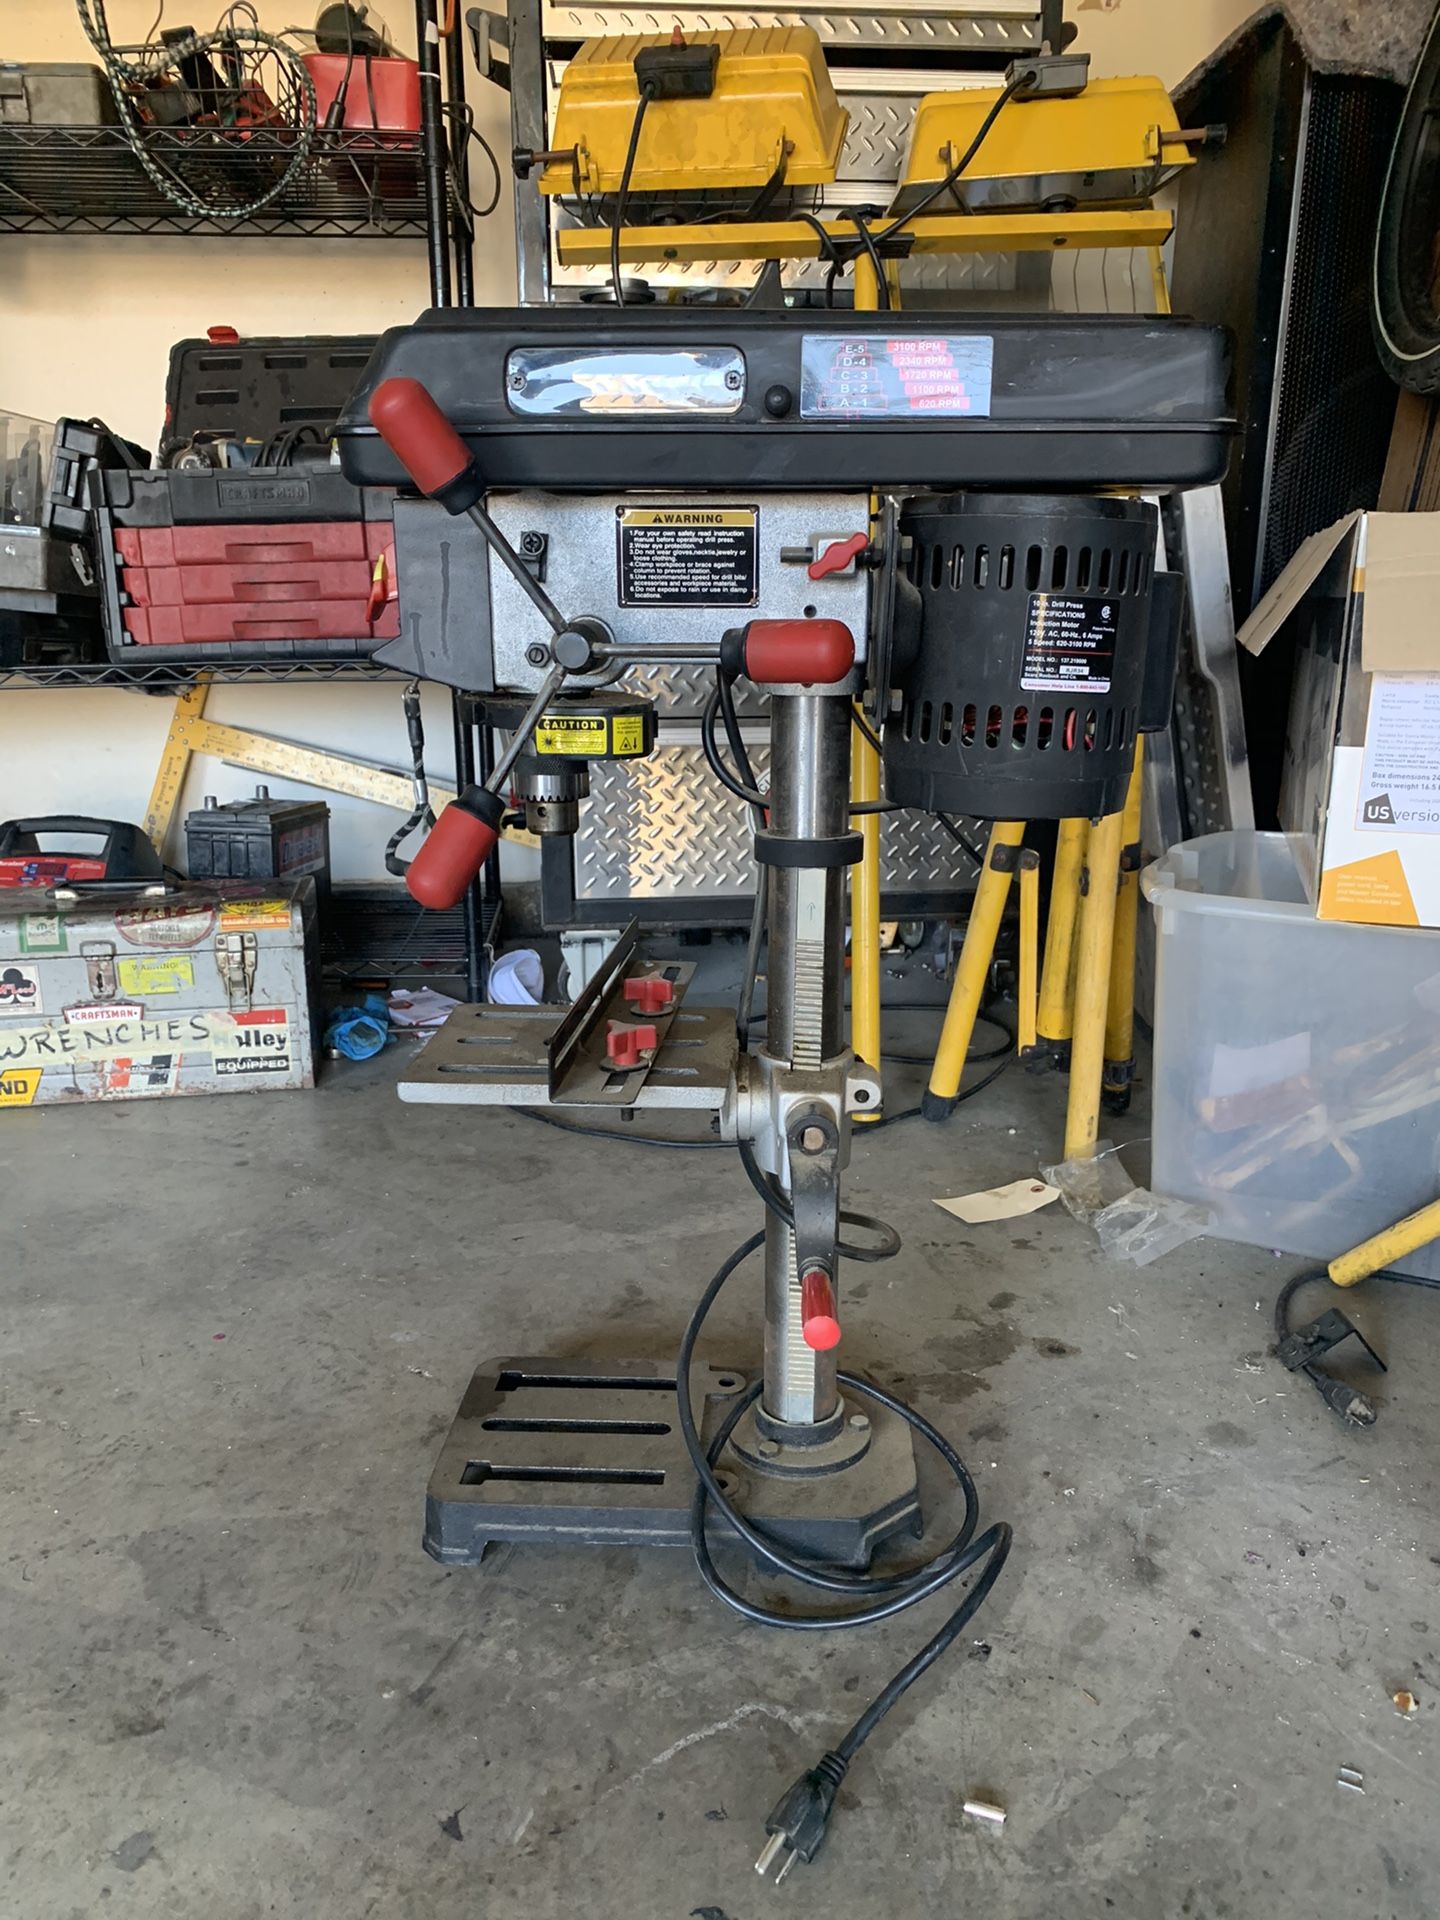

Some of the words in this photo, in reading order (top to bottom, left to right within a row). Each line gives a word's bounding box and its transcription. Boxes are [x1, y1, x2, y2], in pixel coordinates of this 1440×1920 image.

[894, 343, 916, 352] 3100
[919, 342, 940, 350] RPM
[924, 356, 946, 366] RPM
[930, 370, 951, 379] RPM
[938, 384, 960, 394] RPM
[919, 399, 935, 408] 620
[940, 399, 960, 407] RPM
[664, 514, 724, 524] WARNING
[1032, 610, 1085, 619] SPECIFICATIONS
[543, 720, 597, 729] CAUTION
[1368, 806, 1390, 820] US
[75, 1010, 134, 1020] CRAFTSMAN
[0, 1015, 210, 1060] WRENCHES
[217, 1058, 288, 1072] EQUIPPED
